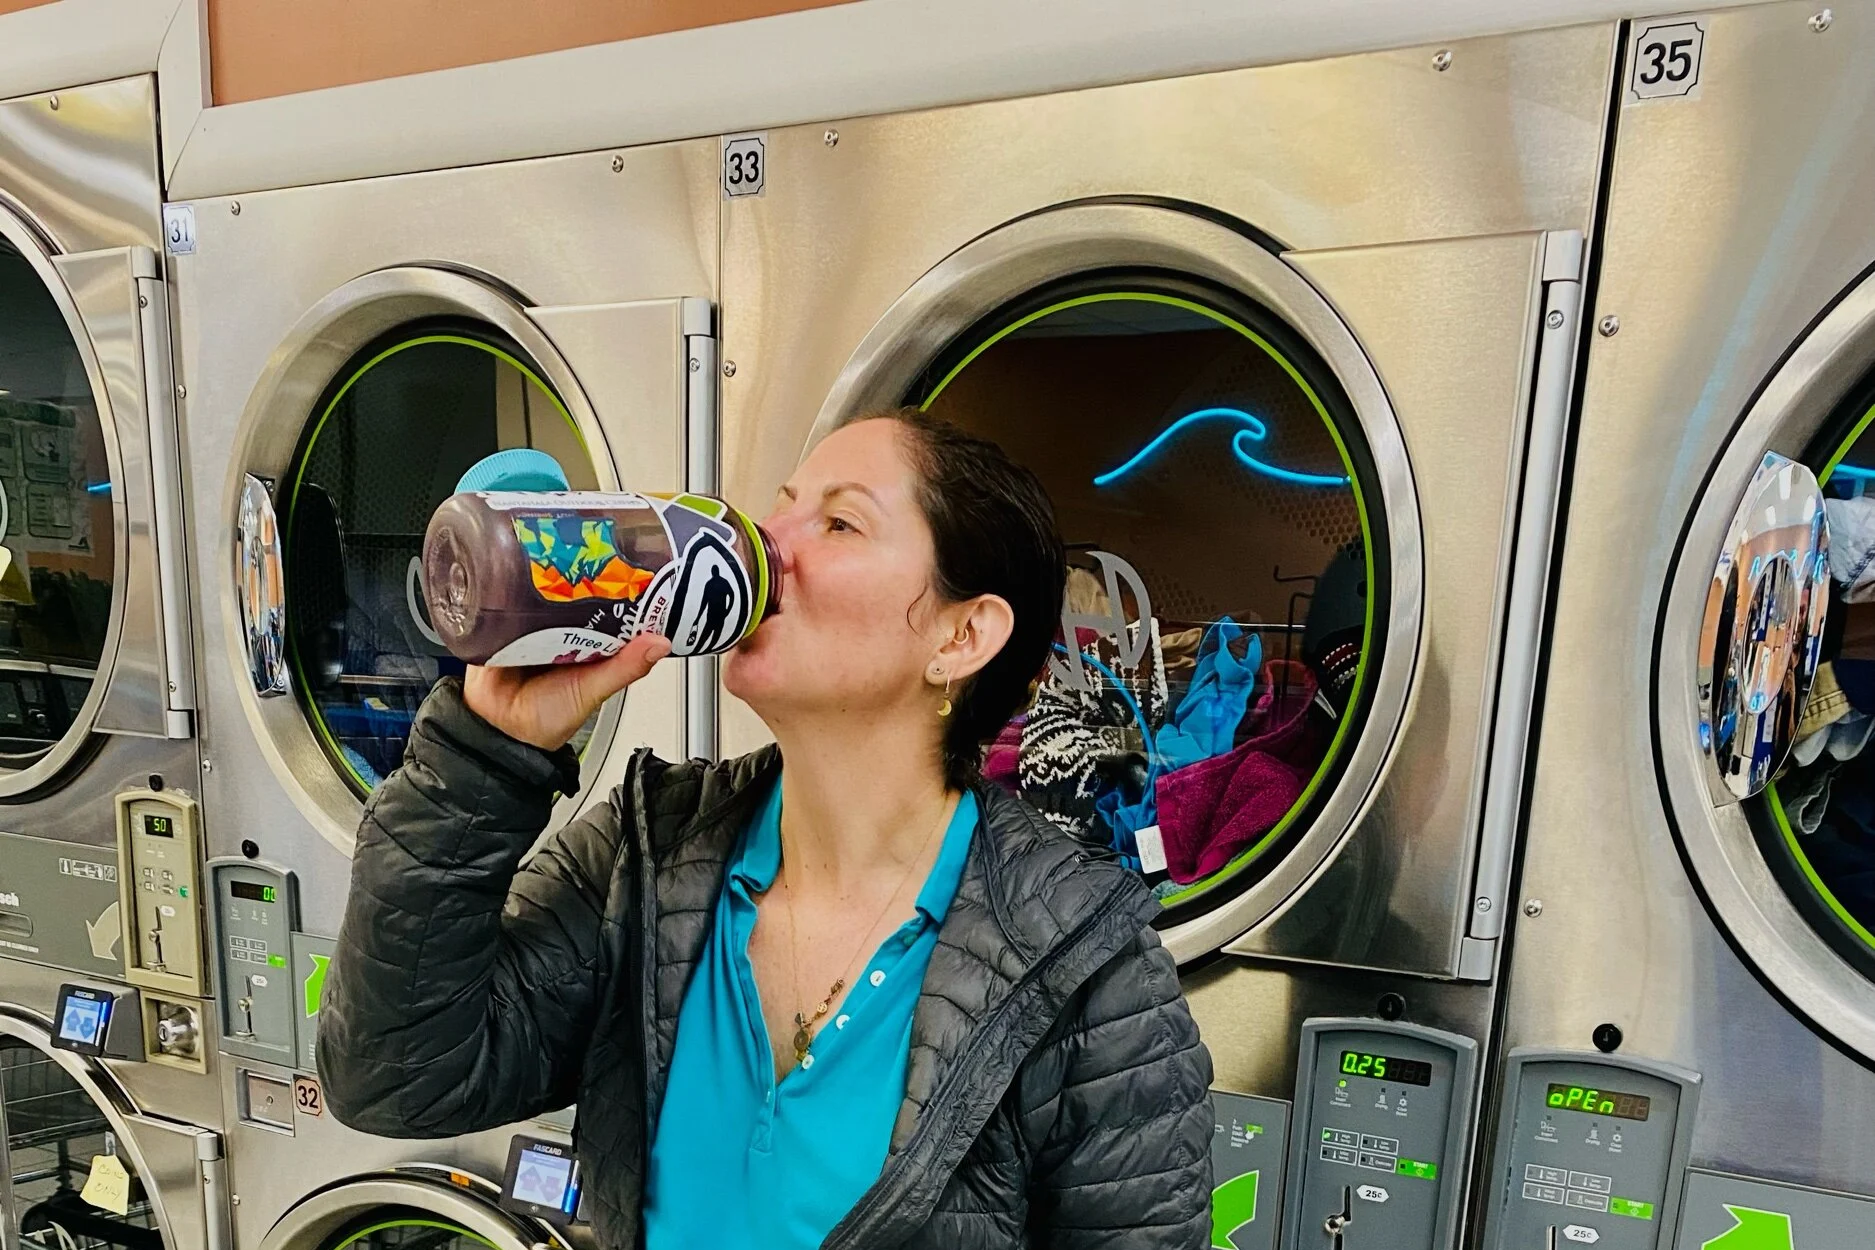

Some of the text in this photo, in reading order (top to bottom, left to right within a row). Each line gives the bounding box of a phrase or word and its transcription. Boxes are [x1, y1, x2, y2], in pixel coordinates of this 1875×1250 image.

[1640, 39, 1693, 84] 35
[729, 151, 759, 184] 33
[171, 217, 188, 243] 31
[563, 633, 602, 649] Three
[1342, 1053, 1386, 1077] 0.25
[298, 1085, 318, 1109] 32
[533, 1144, 562, 1156] FASCARD
